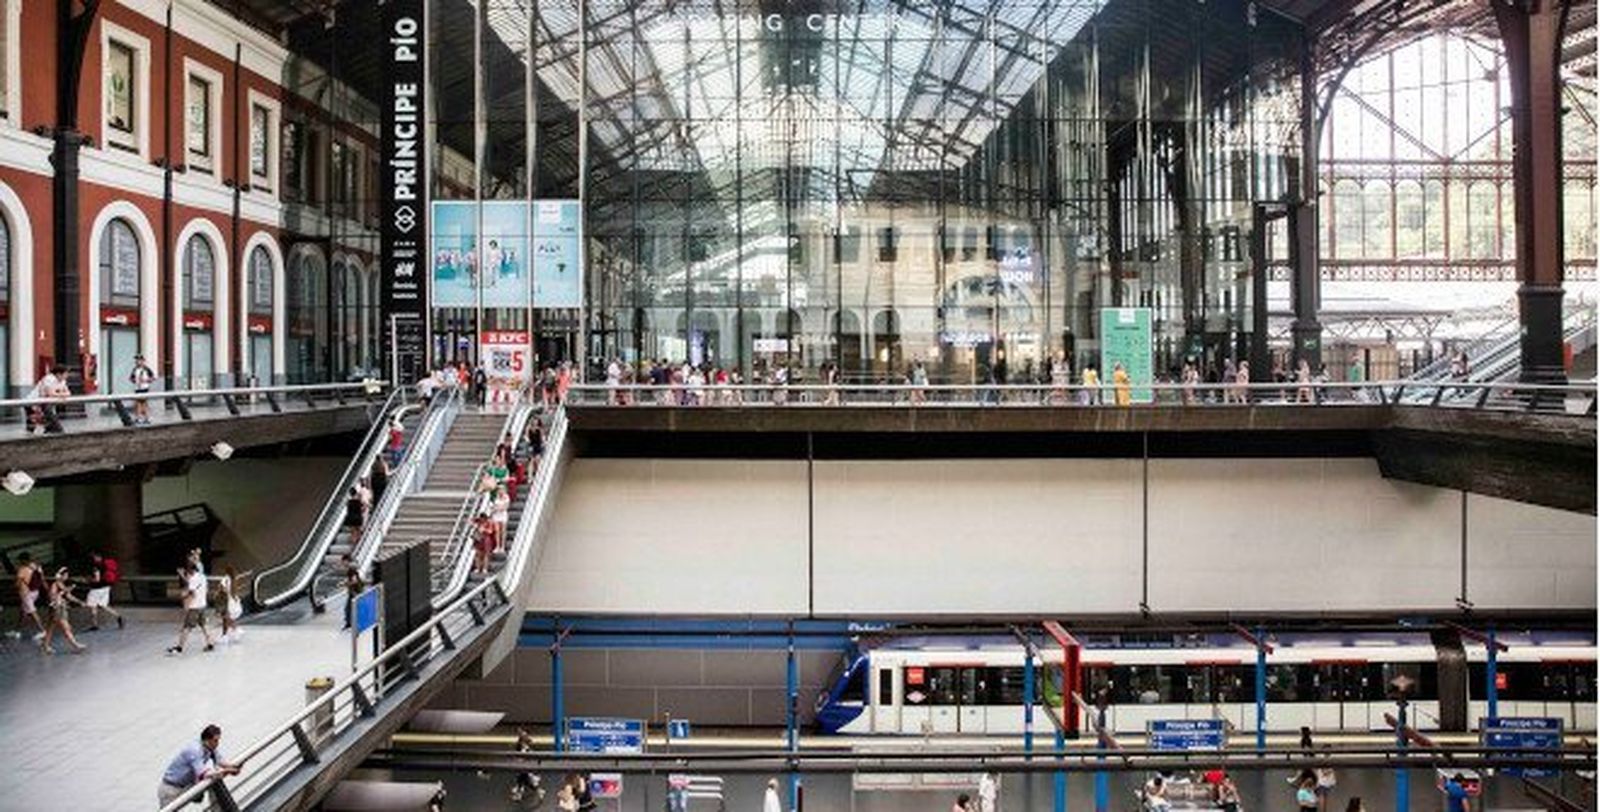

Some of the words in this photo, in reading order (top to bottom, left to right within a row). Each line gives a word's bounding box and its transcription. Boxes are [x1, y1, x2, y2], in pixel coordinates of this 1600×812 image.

[389, 17, 417, 62] PÍO
[389, 83, 417, 200] PRÍNCIPE
[513, 350, 523, 372] 5
